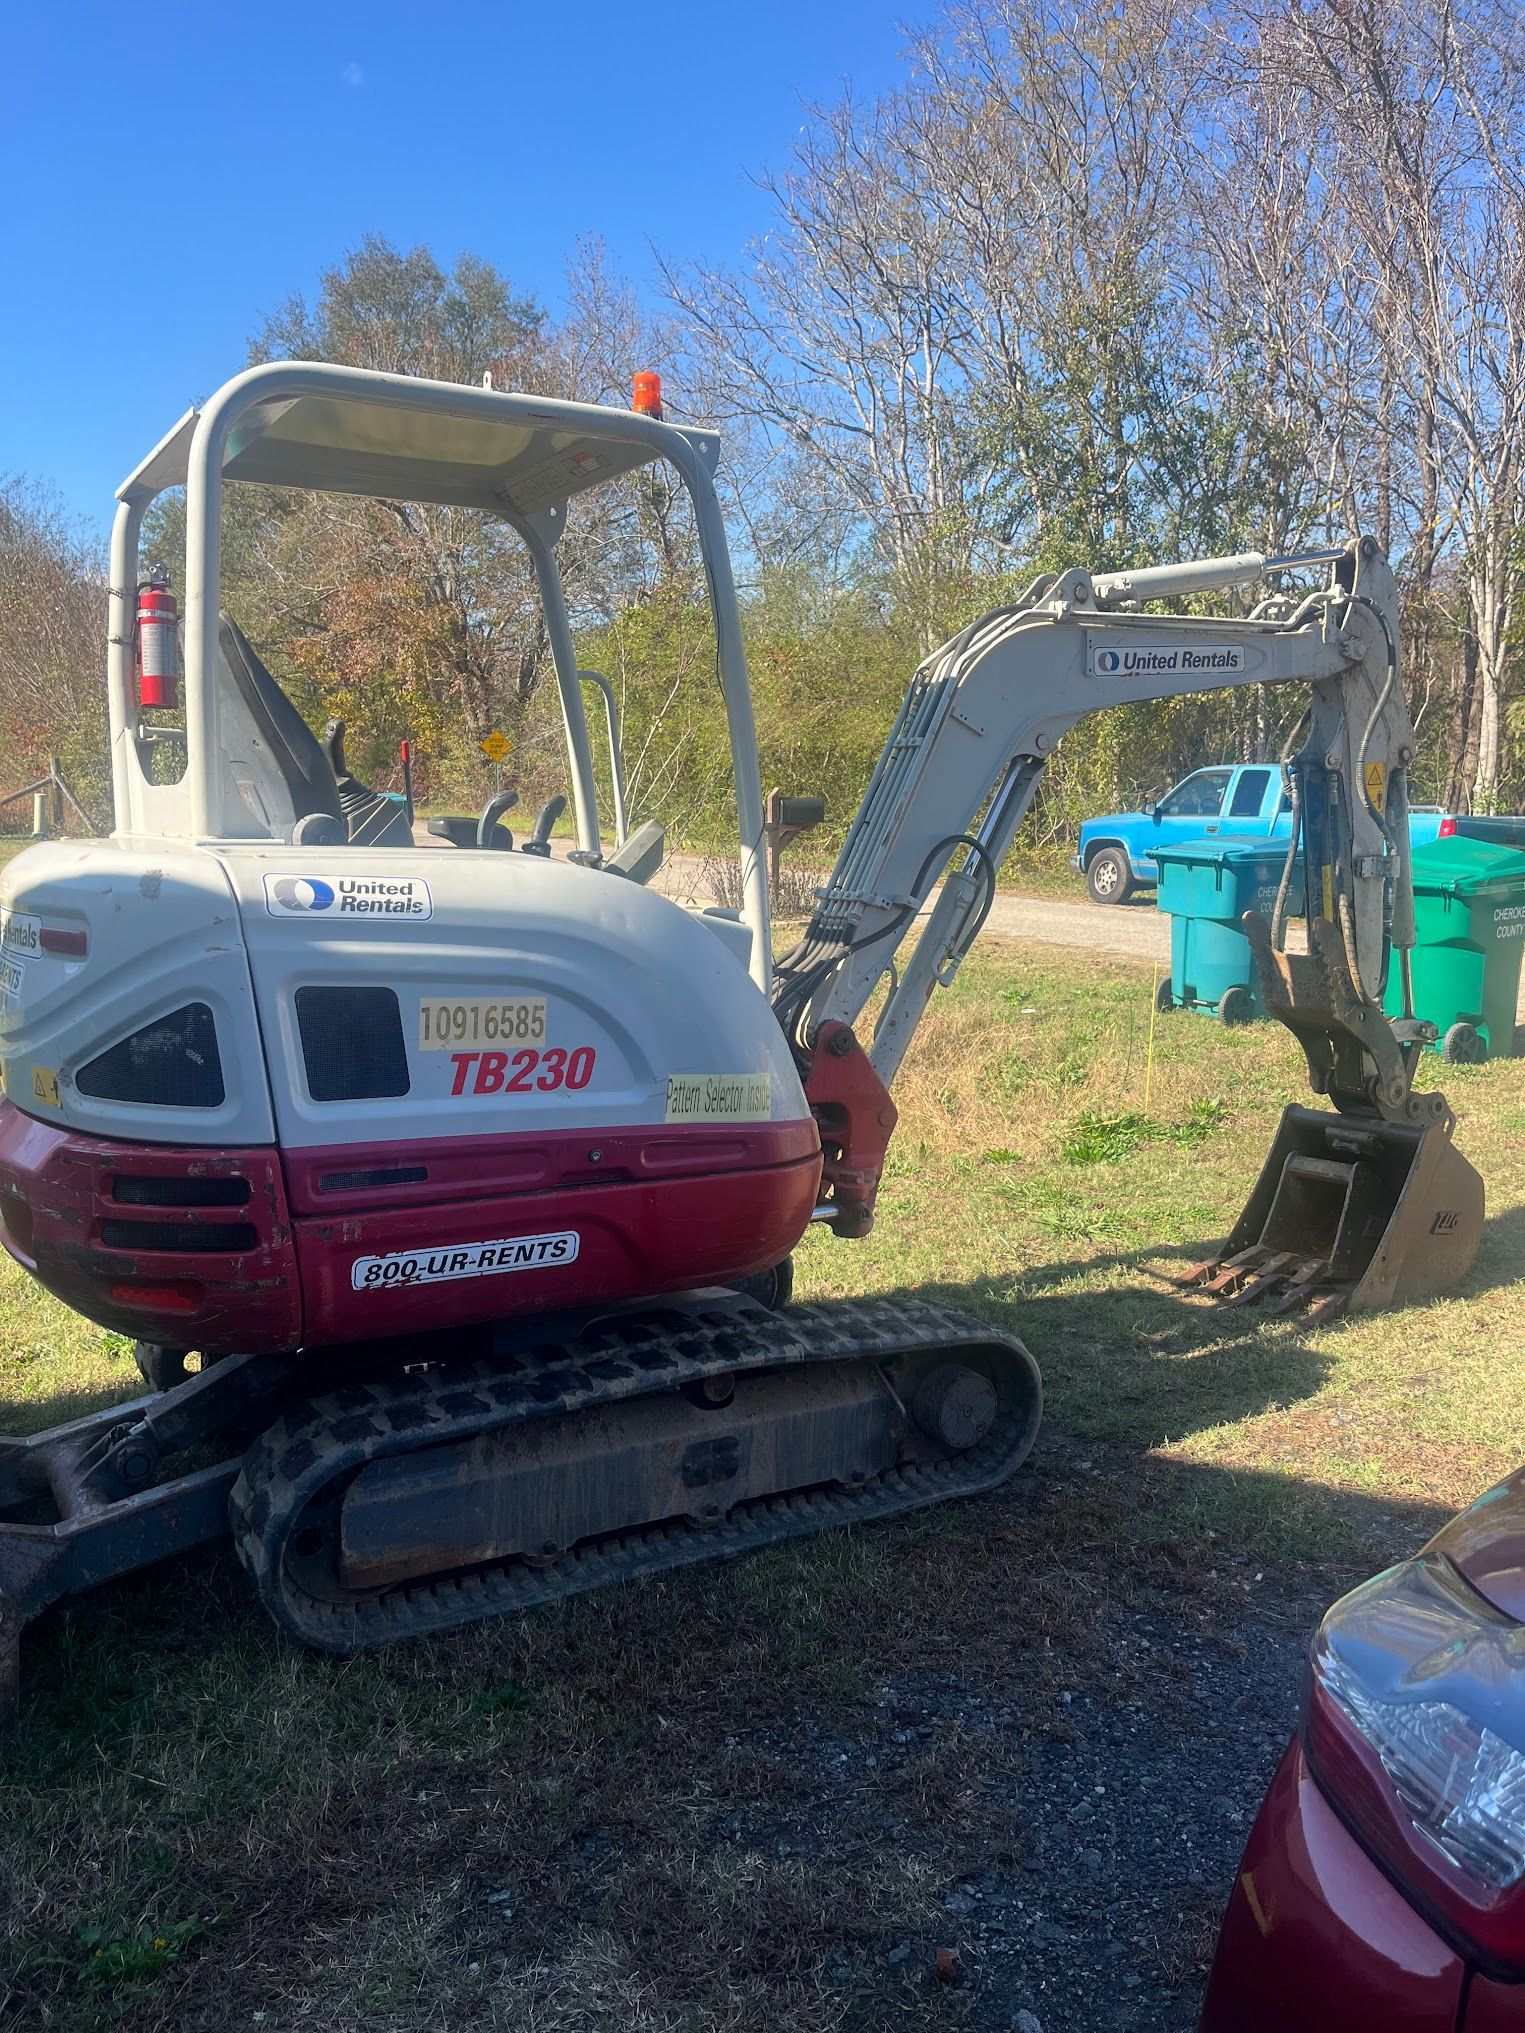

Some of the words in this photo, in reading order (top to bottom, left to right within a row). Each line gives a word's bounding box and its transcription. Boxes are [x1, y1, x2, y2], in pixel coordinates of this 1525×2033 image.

[1123, 652, 1178, 670] United
[1181, 650, 1238, 668] Rentals
[339, 880, 413, 896] United
[340, 895, 424, 914] Rentals
[1496, 923, 1525, 939] COUNTY
[421, 1005, 544, 1041] 10916585
[450, 1046, 596, 1096] TB230
[665, 1078, 701, 1114] Pattern
[704, 1076, 743, 1113] Selector
[746, 1077, 770, 1112] Inside
[363, 1239, 568, 1283] 800-UR-RENTS
